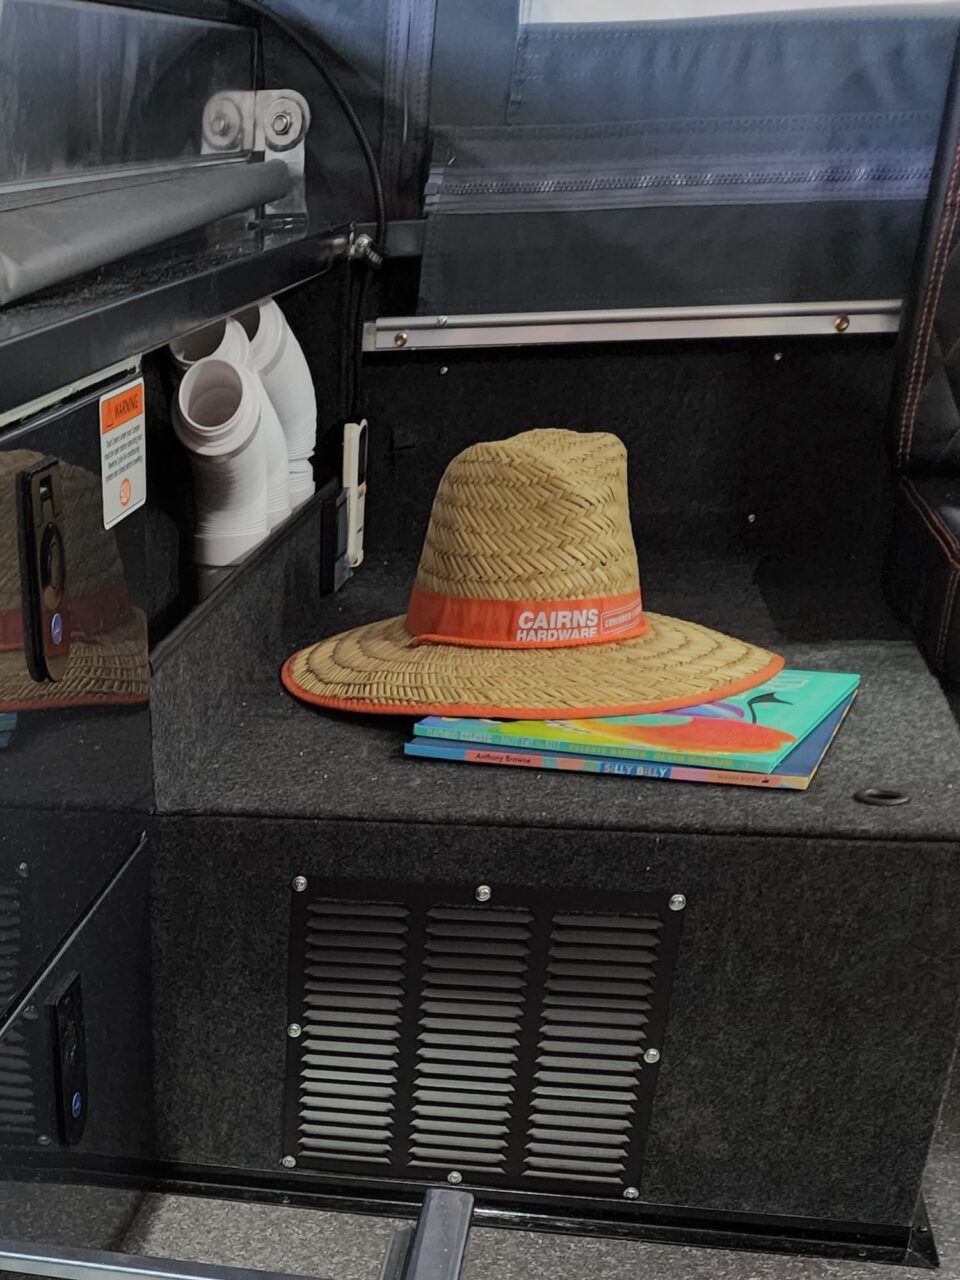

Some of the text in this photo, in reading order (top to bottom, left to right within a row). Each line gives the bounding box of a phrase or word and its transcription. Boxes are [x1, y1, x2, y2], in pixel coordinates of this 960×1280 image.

[114, 393, 138, 419] WARNING
[518, 608, 599, 629] CAIRNS
[516, 627, 598, 642] HARDWARE
[476, 752, 504, 764] Anthony
